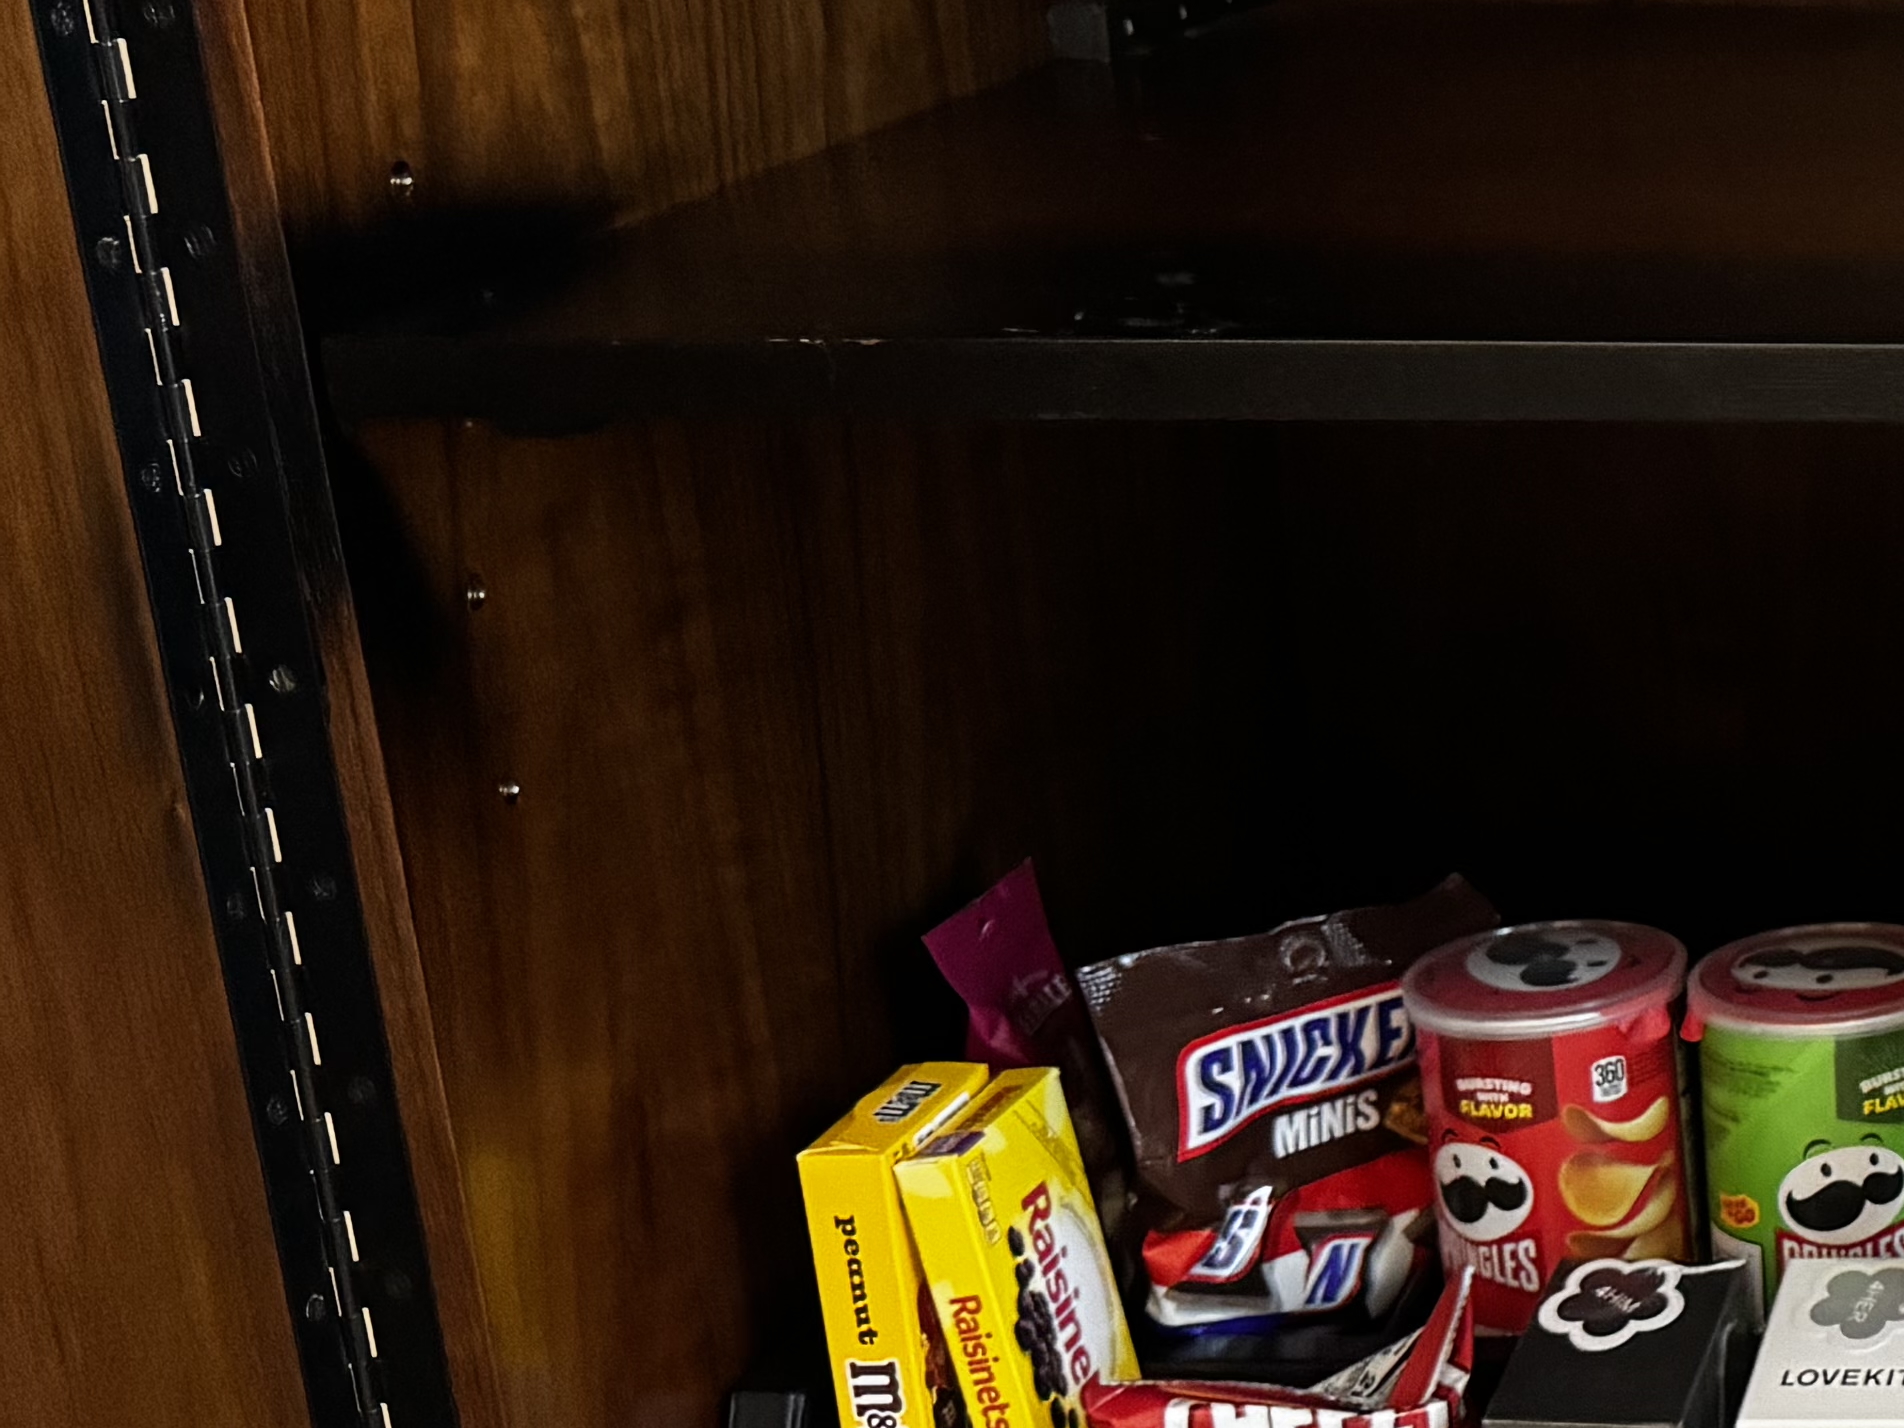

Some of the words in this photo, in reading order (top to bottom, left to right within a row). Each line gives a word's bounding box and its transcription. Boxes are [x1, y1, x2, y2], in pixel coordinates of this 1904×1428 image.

[1594, 1059, 1625, 1088] 360
[1459, 1098, 1533, 1119] FLAVOR
[834, 1215, 878, 1346] peanut
